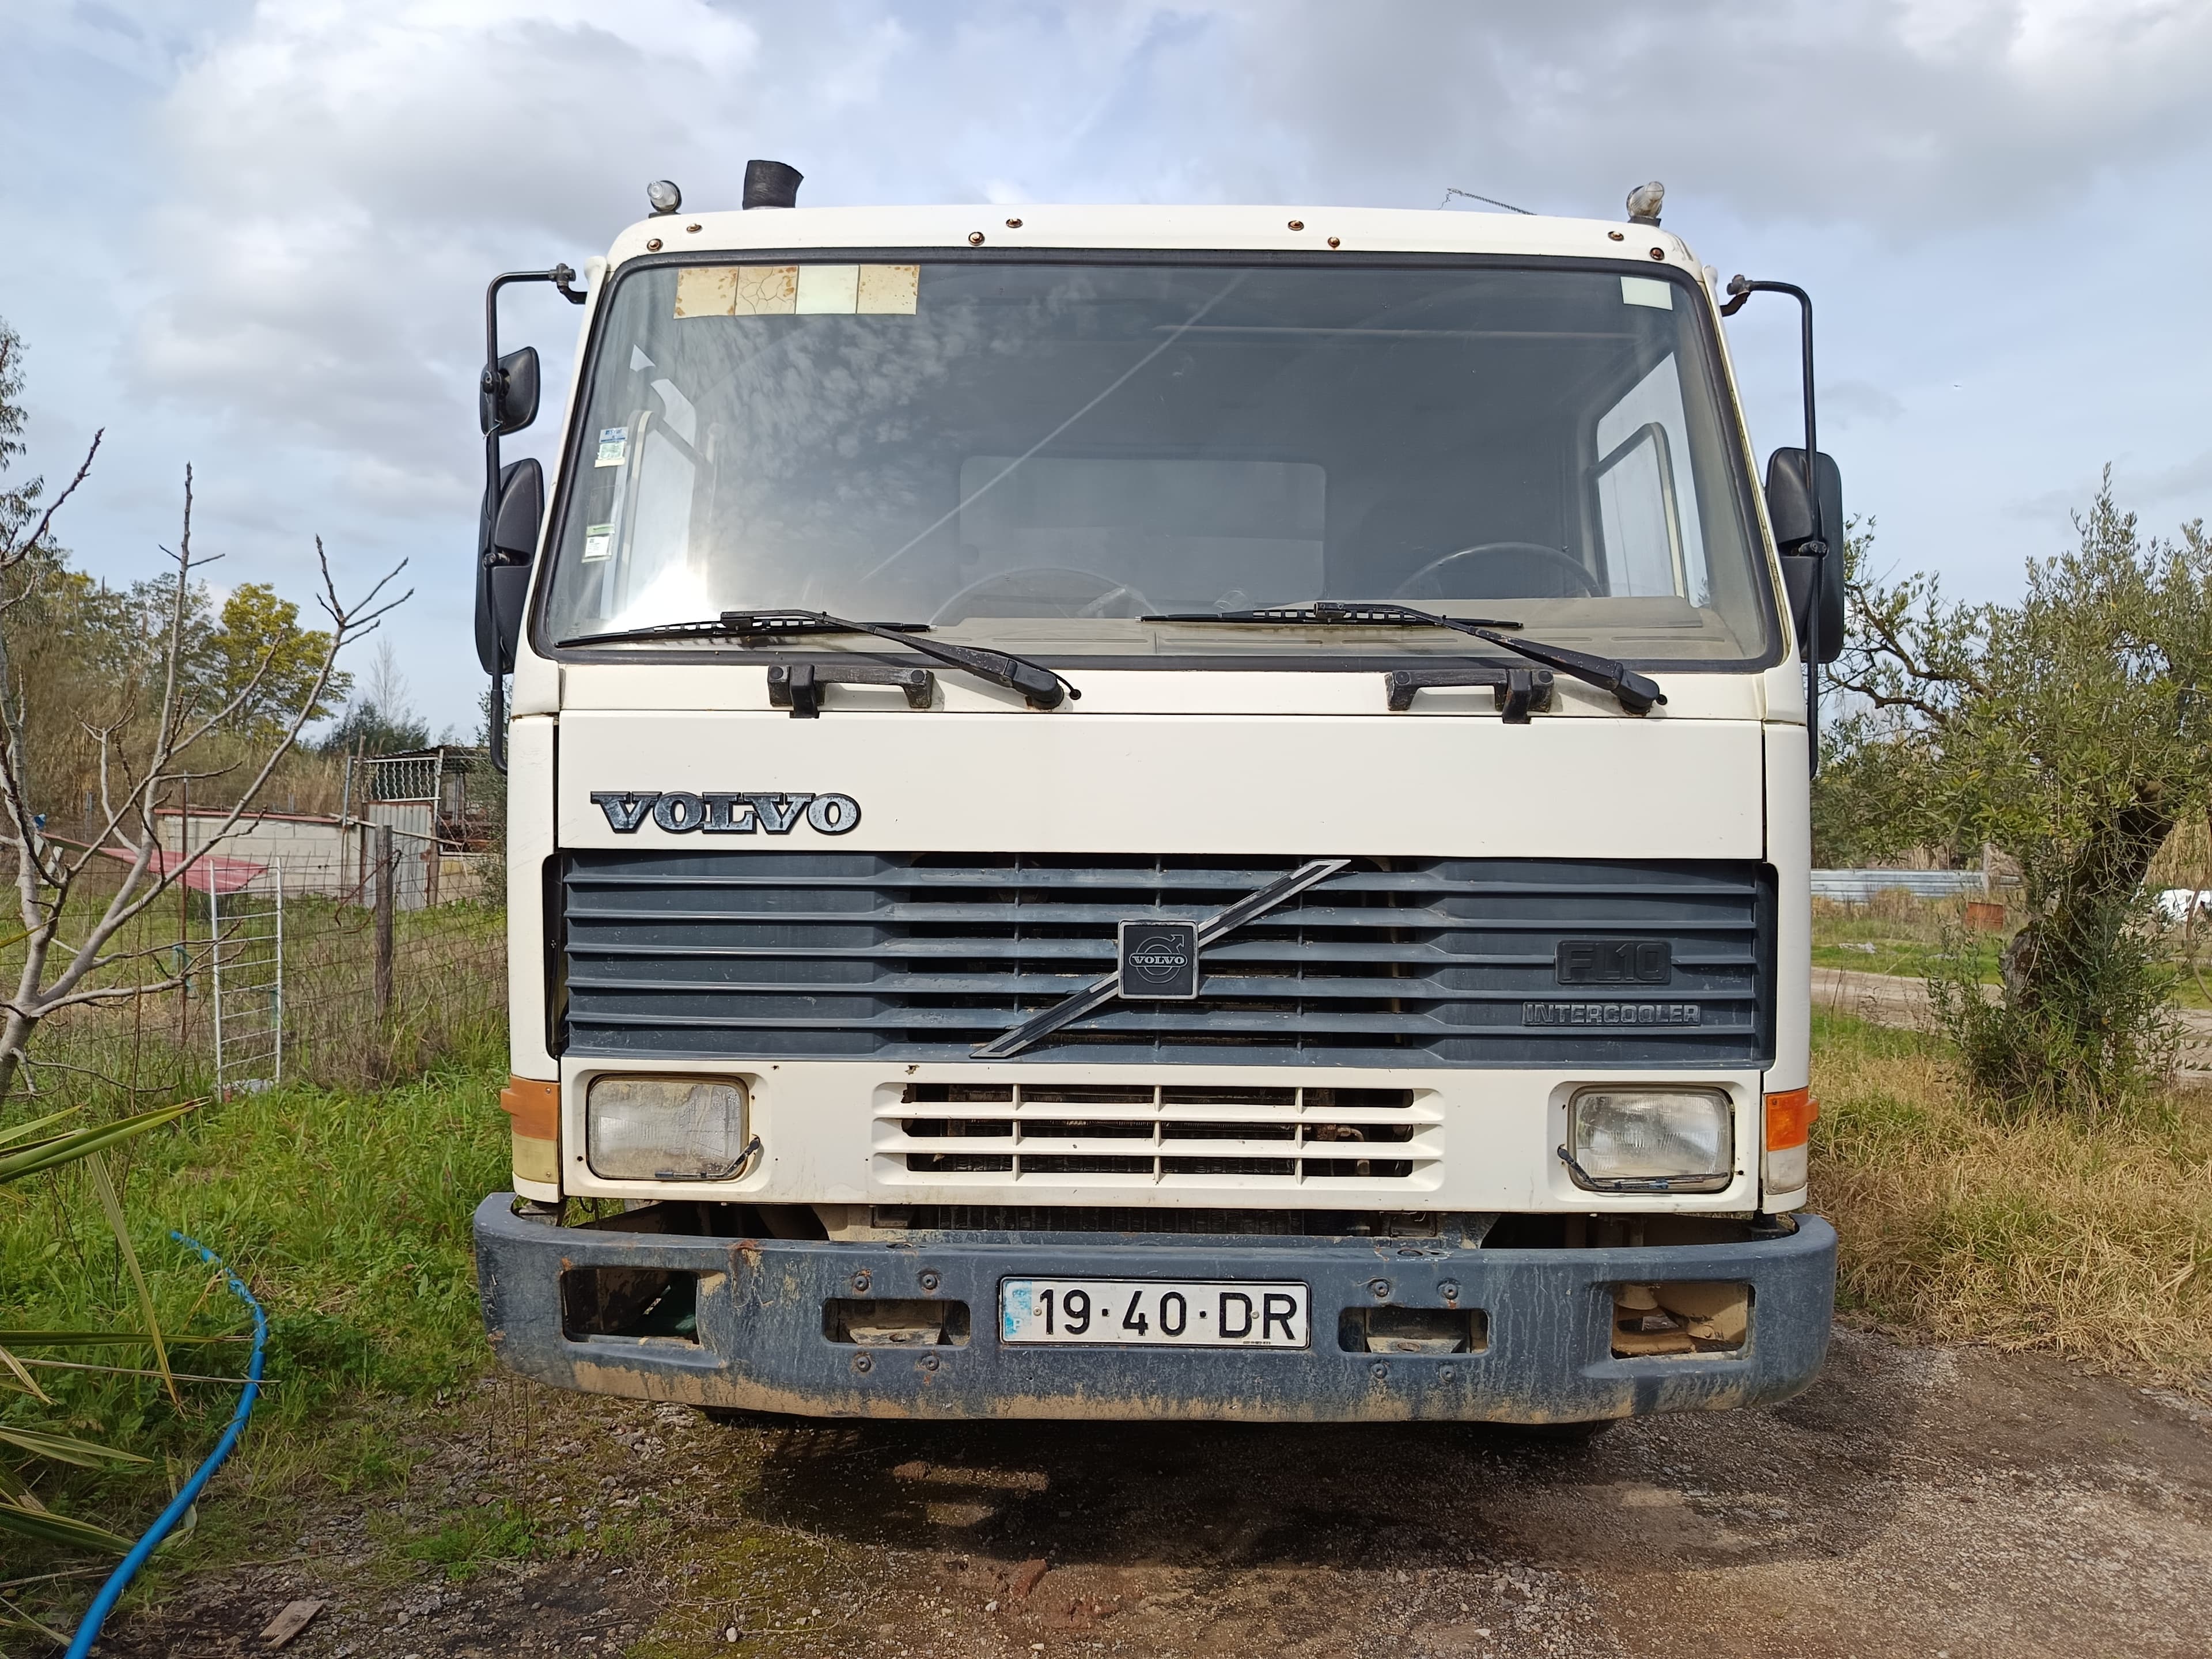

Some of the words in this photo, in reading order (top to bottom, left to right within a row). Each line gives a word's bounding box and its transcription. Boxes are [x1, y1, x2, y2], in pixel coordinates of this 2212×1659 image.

[590, 791, 861, 835] VOLVO
[1132, 956, 1185, 964] VOLVO
[1562, 943, 1666, 980] FL10
[1527, 1004, 1699, 1024] INTERCOOLER
